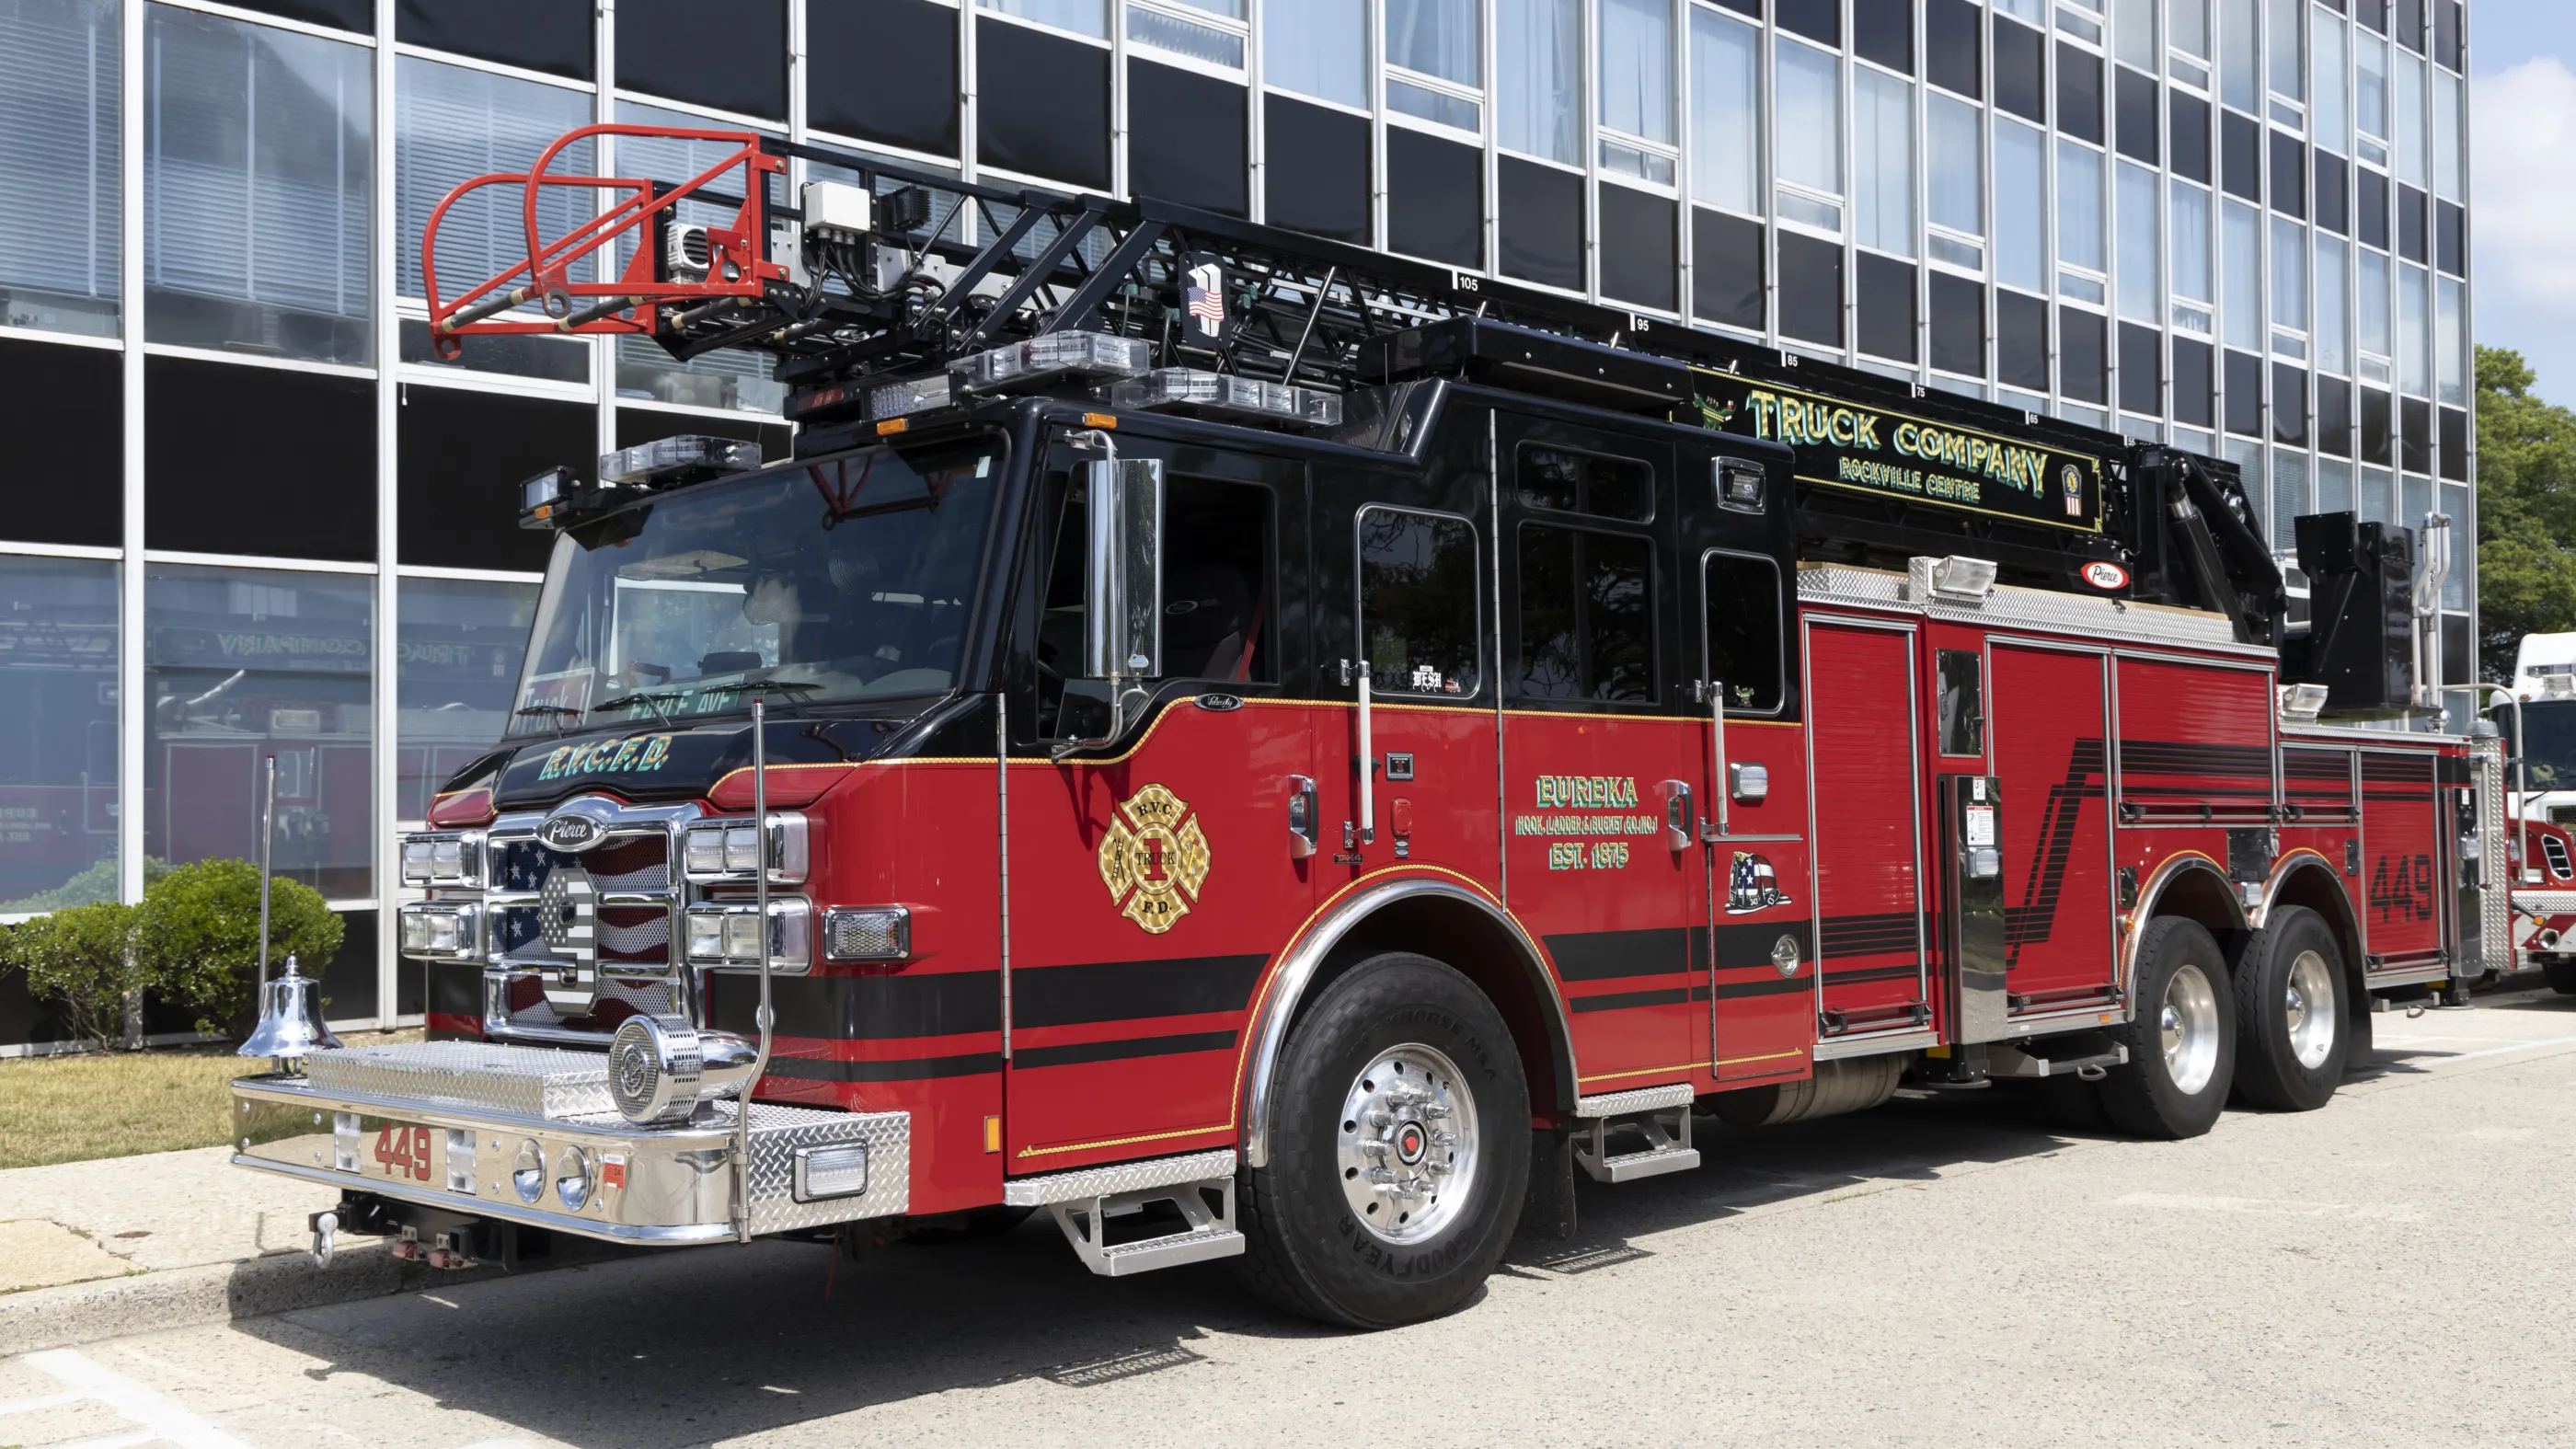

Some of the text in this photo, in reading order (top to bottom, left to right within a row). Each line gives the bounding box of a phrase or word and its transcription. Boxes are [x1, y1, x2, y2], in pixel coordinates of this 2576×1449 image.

[1459, 276, 1478, 292] 105
[1637, 317, 1650, 331] 95
[1787, 354, 1798, 367] 85
[1916, 385, 1926, 397] 75
[2030, 413, 2039, 424] 65
[1745, 389, 2049, 500] TRUCK COMPANY
[1838, 455, 1981, 503] ROCKVILLE CENTRE
[2092, 565, 2119, 582] Pierce
[1207, 696, 1234, 708] Velocity
[1535, 776, 1639, 808] EUREKA
[1137, 801, 1173, 817] R.V.C.
[548, 819, 588, 842] Pierce
[1515, 815, 1546, 837] HOOK,
[1546, 815, 1581, 835] LADDER
[1581, 815, 1590, 835] &
[1590, 815, 1624, 835] BUCKET
[1135, 851, 1176, 866] TRUCK
[1143, 837, 1168, 880] 1
[1549, 842, 1629, 869] EST. 1875
[2369, 854, 2432, 924] 449
[540, 868, 599, 1018] 9
[374, 1121, 432, 1182] 449
[1337, 1213, 1473, 1279] GOODYEAR
